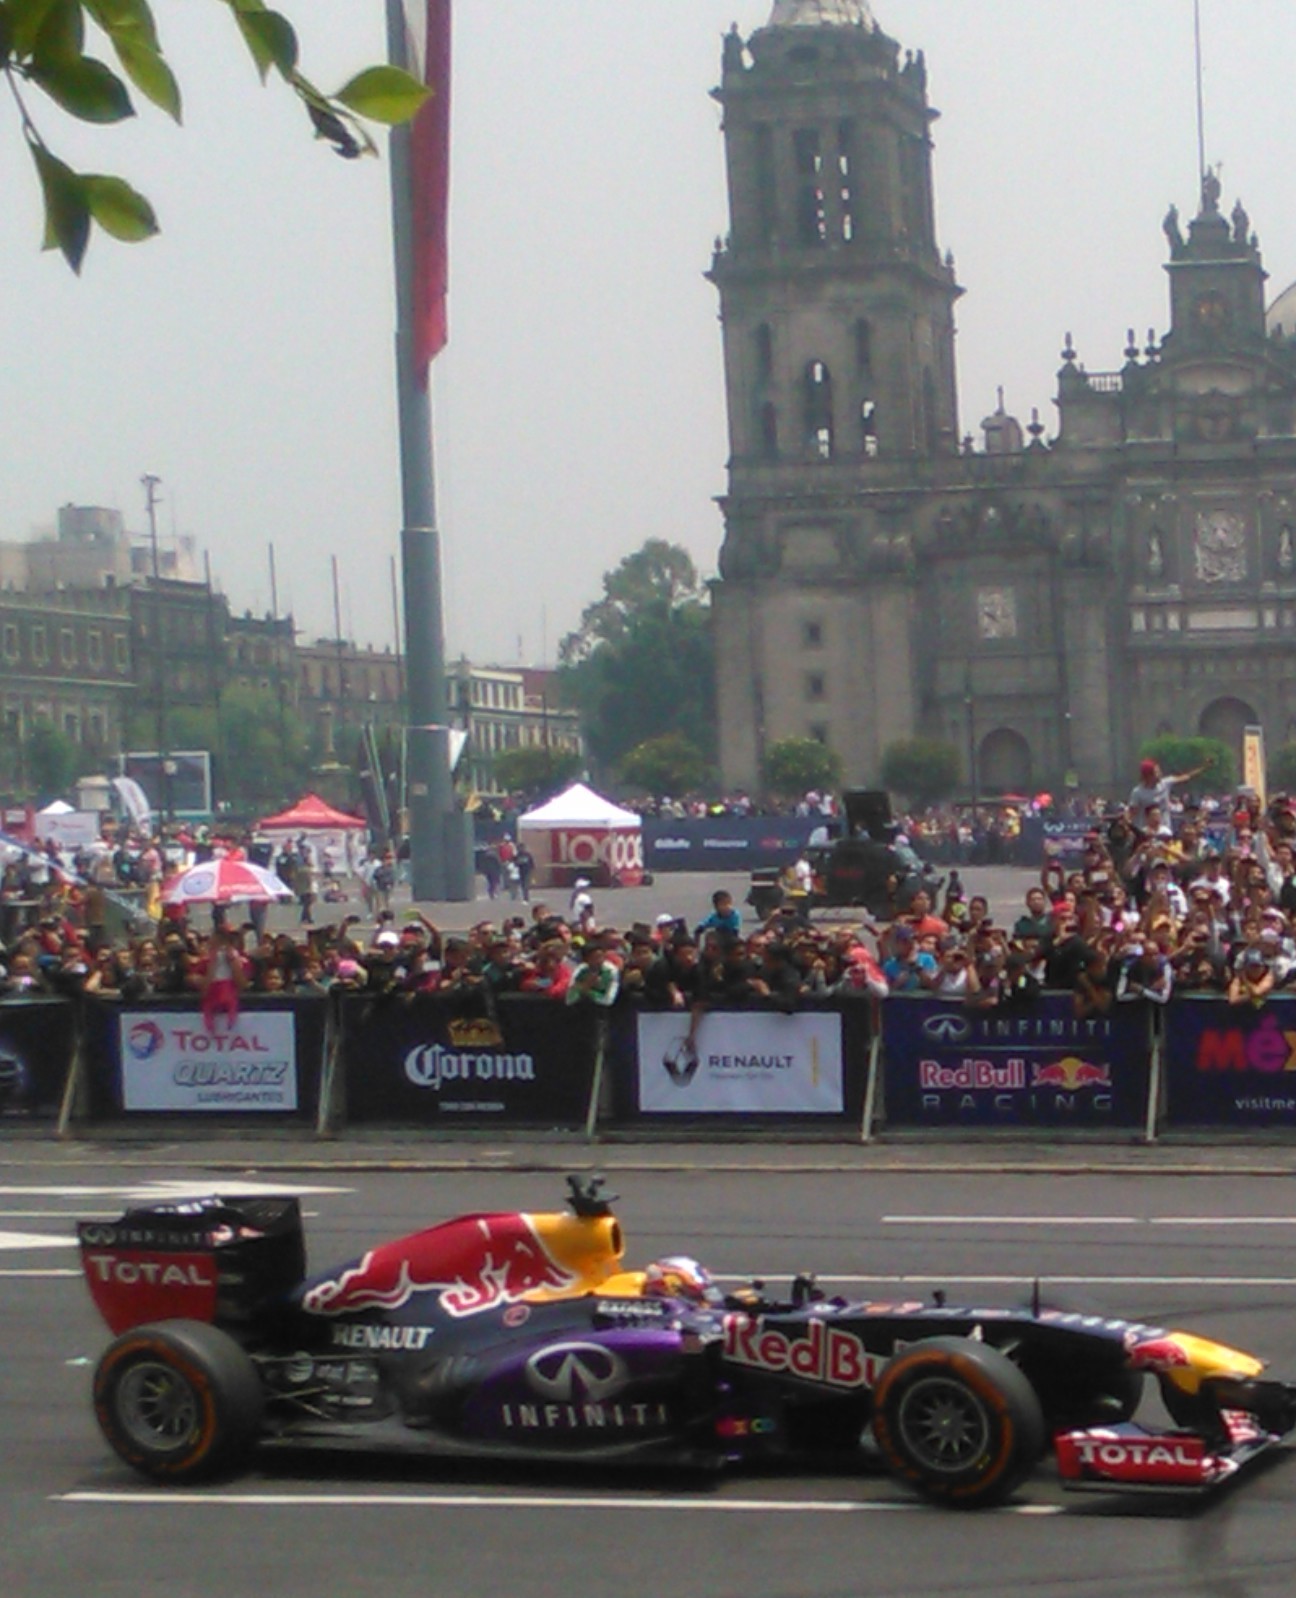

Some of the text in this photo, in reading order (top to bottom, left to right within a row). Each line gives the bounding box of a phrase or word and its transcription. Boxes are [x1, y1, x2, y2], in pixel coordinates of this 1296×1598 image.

[980, 1019, 1111, 1035] INFINITI
[172, 1030, 269, 1052] TOTAL
[404, 1043, 536, 1091] Corona
[708, 1055, 794, 1068] RENAULT
[174, 1060, 288, 1087] QUARTZ
[922, 1094, 1112, 1109] RACING
[89, 1255, 212, 1286] TOTAL
[332, 1324, 434, 1349] RENAULT
[502, 1404, 666, 1426] INFINITI
[1074, 1441, 1198, 1465] TOTAL
